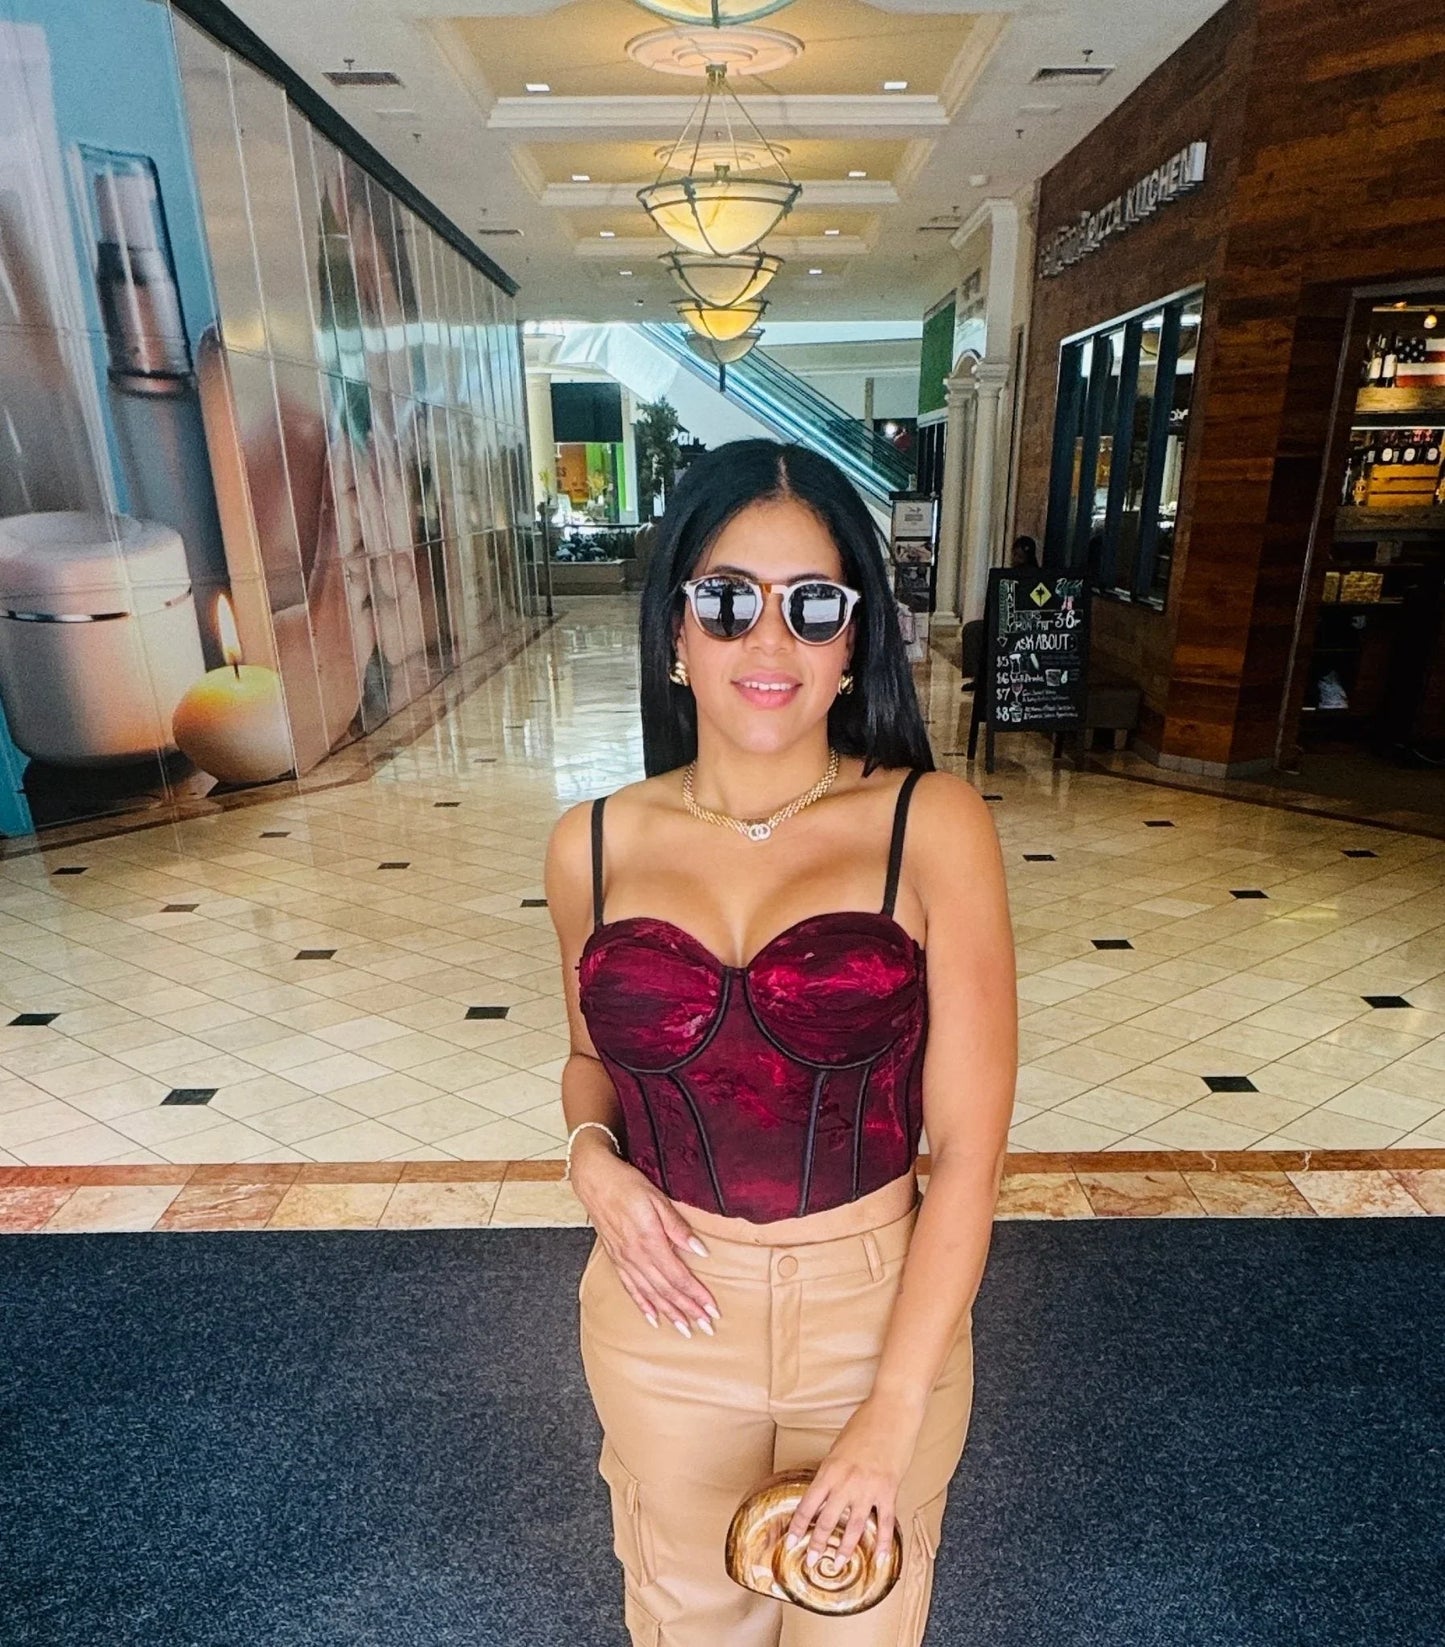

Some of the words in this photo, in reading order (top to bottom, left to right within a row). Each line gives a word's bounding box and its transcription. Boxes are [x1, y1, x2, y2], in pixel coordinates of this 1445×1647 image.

[1014, 634, 1034, 651] ASK
[996, 687, 1011, 701] $7
[996, 705, 1010, 721] $8
